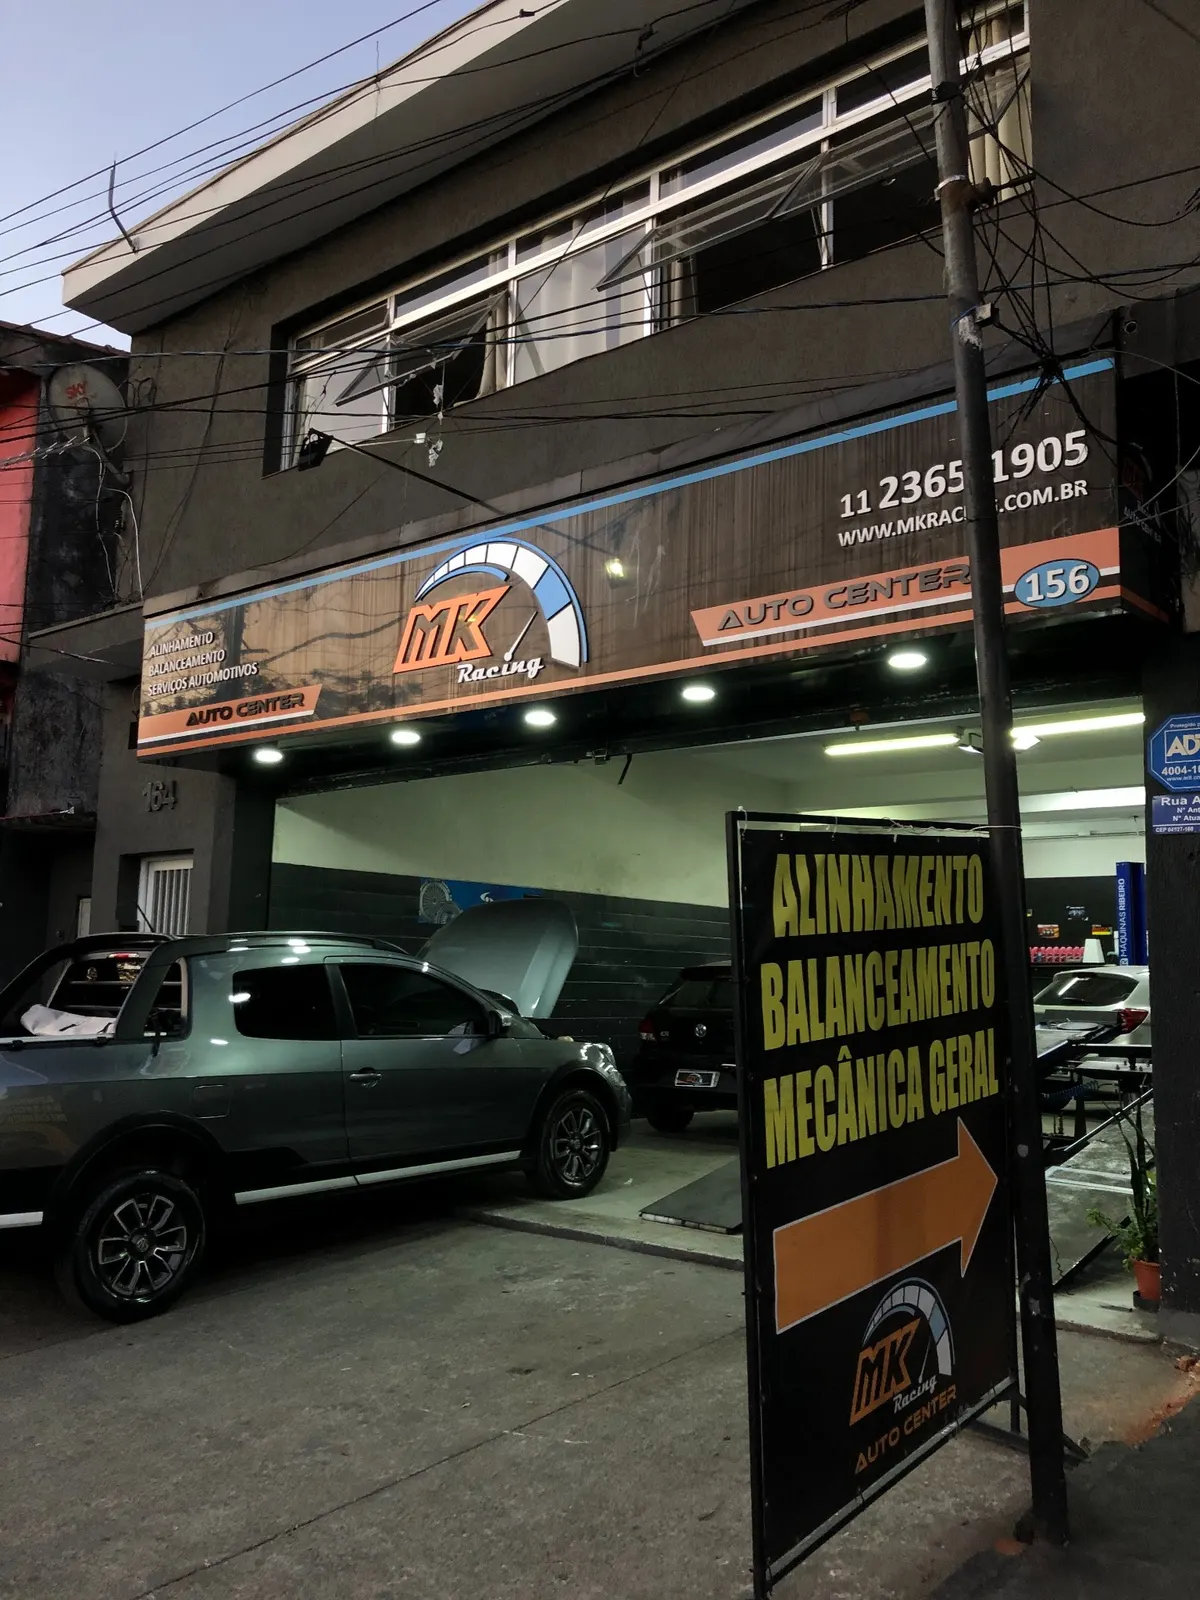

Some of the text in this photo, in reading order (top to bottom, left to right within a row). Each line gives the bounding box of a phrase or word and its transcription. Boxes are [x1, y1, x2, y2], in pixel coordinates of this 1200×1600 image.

[838, 479, 1089, 547] WWW.MKRAC.COM.BR
[839, 488, 870, 518] 11
[717, 563, 972, 632] AUTO CENTER
[1025, 564, 1090, 603] 156
[150, 632, 214, 657] ALINHAMENTO
[392, 585, 511, 673] MK
[148, 662, 258, 696] SERVIÇOS AUTOMOTIVOS
[149, 650, 226, 677] BALANCEAMENTO
[457, 655, 545, 684] Racing
[186, 693, 305, 727] AUTO CENTER
[142, 780, 178, 812] 164
[1161, 796, 1188, 806] Rua
[772, 853, 984, 938] ALINHAMENTO
[1117, 878, 1126, 911] RIBEIRO
[760, 939, 995, 1051] BALANCEAMENTO
[763, 1027, 999, 1170] MECÂNICA GERAL
[849, 1317, 921, 1427] MK
[893, 1374, 937, 1414] Racing
[855, 1384, 957, 1475] AUTO CENTER
